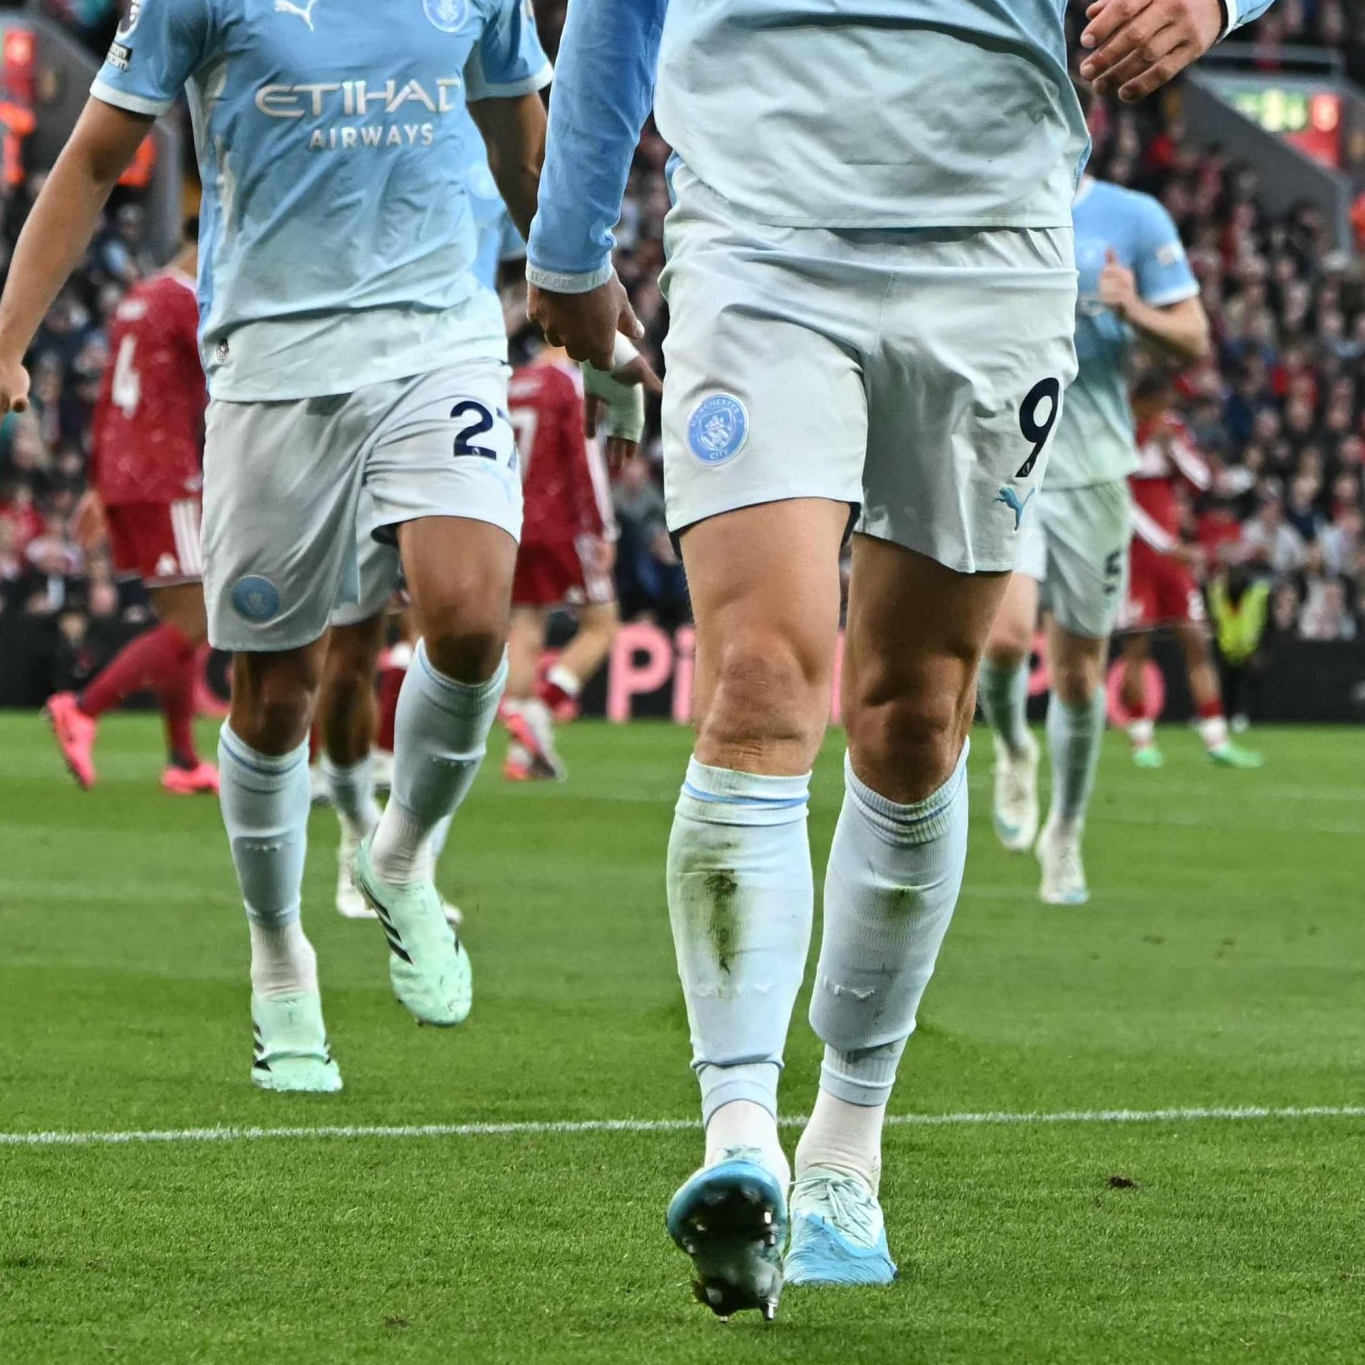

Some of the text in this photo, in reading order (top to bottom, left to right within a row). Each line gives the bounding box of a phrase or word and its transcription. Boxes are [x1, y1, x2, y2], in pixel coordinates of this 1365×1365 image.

[309, 122, 434, 150] AIRWAYS
[111, 333, 141, 419] 4
[1015, 377, 1060, 478] 9
